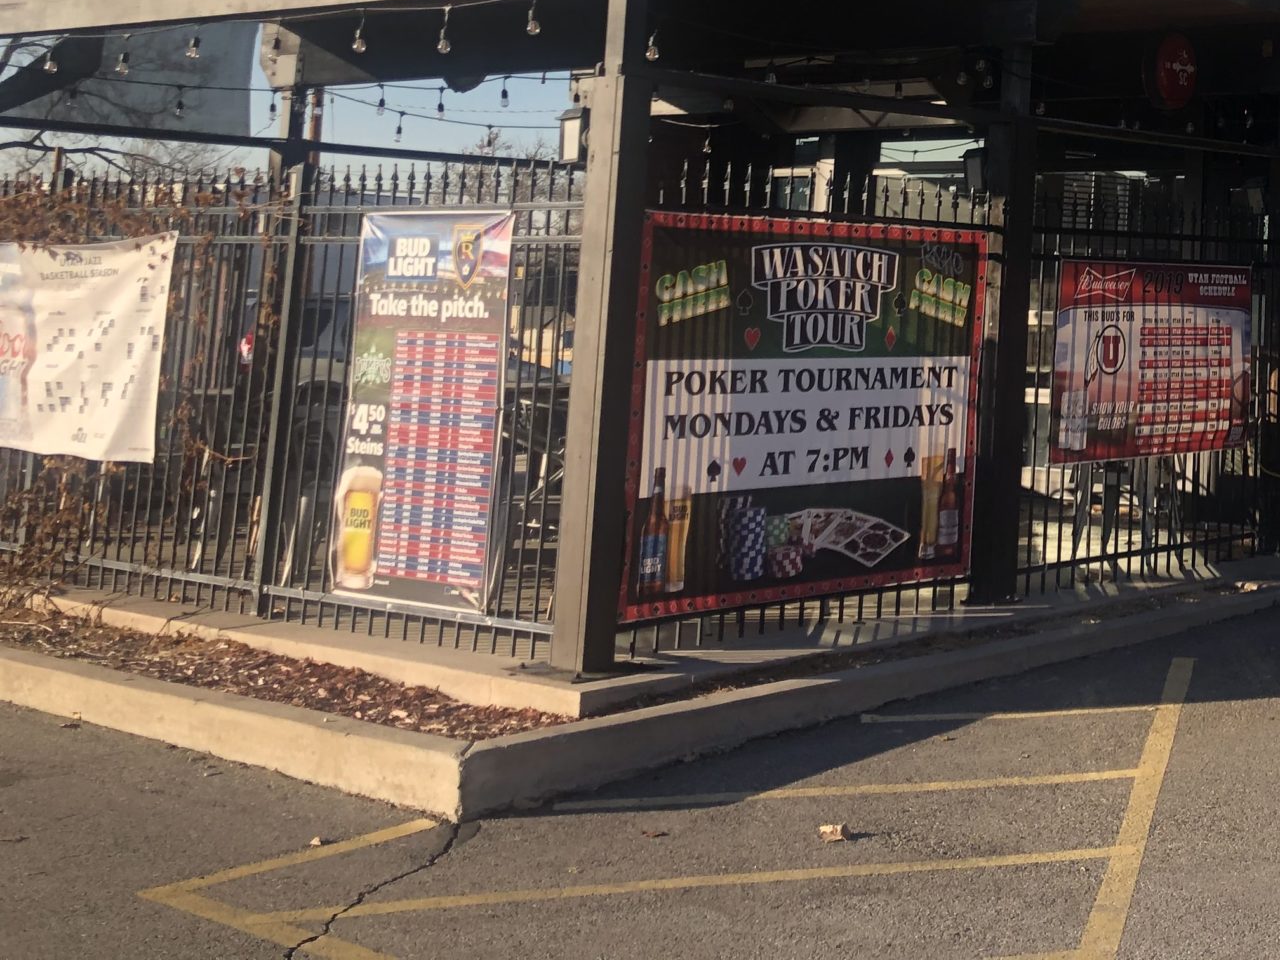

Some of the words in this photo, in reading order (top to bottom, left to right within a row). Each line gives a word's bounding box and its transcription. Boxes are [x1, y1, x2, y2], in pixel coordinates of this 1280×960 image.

[396, 238, 430, 257] BUD
[40, 270, 89, 280] BASKETBALL
[388, 257, 436, 277] LIGHT
[761, 246, 889, 284] WASATCH
[656, 259, 728, 302] CASH
[915, 268, 971, 307] CASH
[1080, 274, 1130, 290] Budweiser
[1143, 271, 1185, 294] 2019
[1188, 272, 1209, 284] UTAH
[1211, 273, 1247, 285] FOOTBALL
[779, 279, 872, 313] POKER
[1200, 285, 1236, 297] SCHEDULE
[369, 294, 407, 316] Take
[410, 293, 439, 317] the
[441, 294, 490, 322] pitch.
[1084, 310, 1099, 322] THIS
[1101, 310, 1120, 322] BUD'S
[1122, 310, 1135, 322] FOR
[790, 313, 861, 345] TOUR
[664, 369, 768, 396] POKER
[778, 366, 958, 392] TOURNAMENT
[1091, 401, 1115, 415] SHOW
[1114, 401, 1135, 414] YOUR
[663, 409, 806, 440] MONDAYS
[816, 409, 840, 431] &
[849, 403, 954, 431] FRIDAYS
[1097, 416, 1127, 431] COLORS
[346, 436, 384, 456] Steins
[759, 450, 796, 477] AT
[806, 446, 869, 473] 7:PM
[350, 508, 370, 518] BUD
